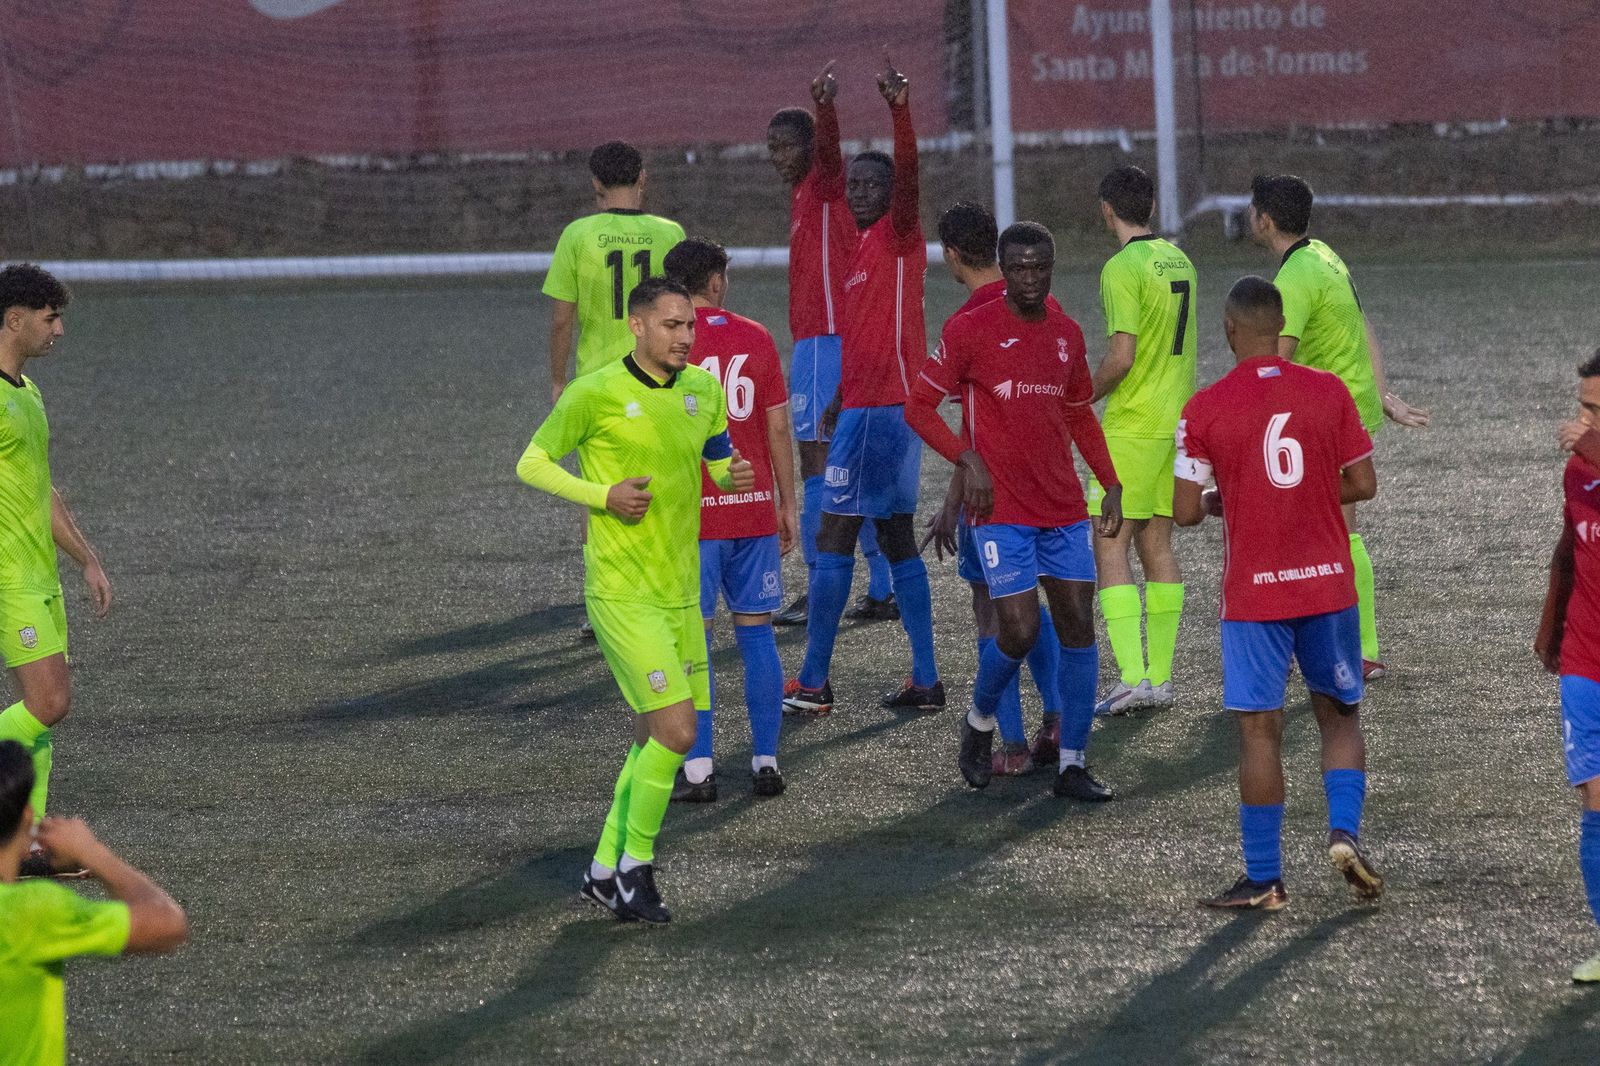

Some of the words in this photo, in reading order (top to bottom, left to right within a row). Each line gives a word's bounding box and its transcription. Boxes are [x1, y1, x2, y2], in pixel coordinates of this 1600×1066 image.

[1290, 2, 1325, 28] de
[1031, 52, 1117, 81] Santa
[1124, 50, 1212, 79] Mrta
[1220, 48, 1253, 76] de
[1264, 45, 1368, 75] Tormes
[1170, 279, 1190, 355] 7
[1263, 412, 1304, 489] 6
[700, 497, 717, 507] YTO.
[719, 493, 753, 505] CUBILLOS
[984, 540, 999, 568] 9
[1253, 572, 1277, 585] AYTO.
[1278, 566, 1317, 582] CUBILLOS
[1318, 564, 1333, 577] DEL
